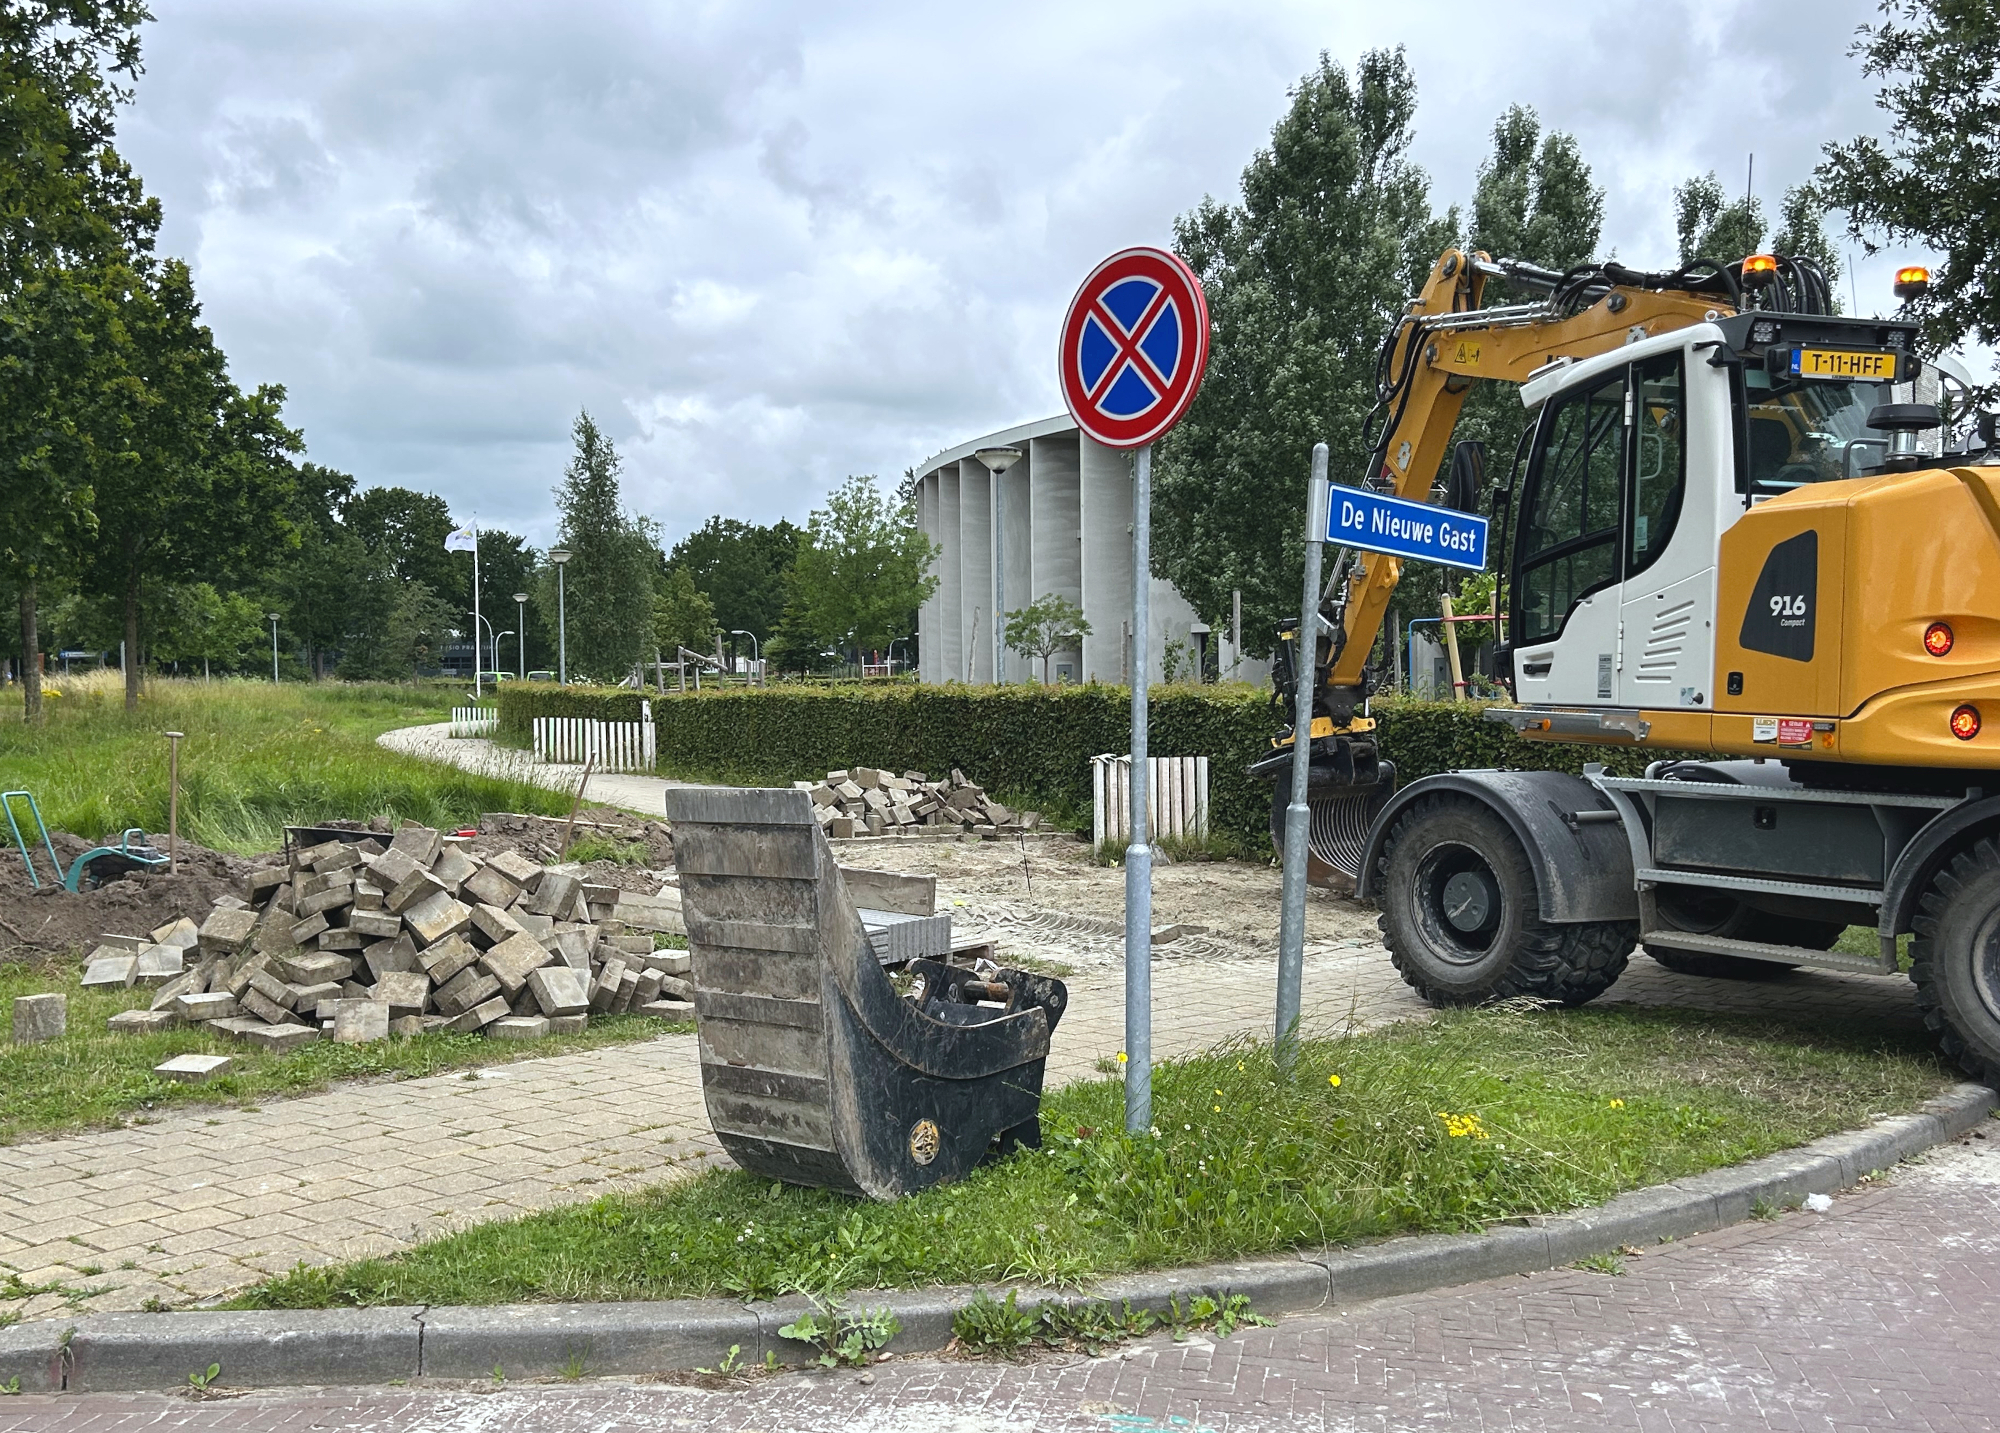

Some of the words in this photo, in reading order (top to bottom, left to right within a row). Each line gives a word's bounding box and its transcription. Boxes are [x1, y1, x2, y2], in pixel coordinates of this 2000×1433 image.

[1812, 353, 1884, 375] T-11-HFF
[1341, 500, 1365, 530] De
[1371, 507, 1433, 544] Nieuwe
[1440, 522, 1476, 553] Gast
[1770, 595, 1806, 616] 916
